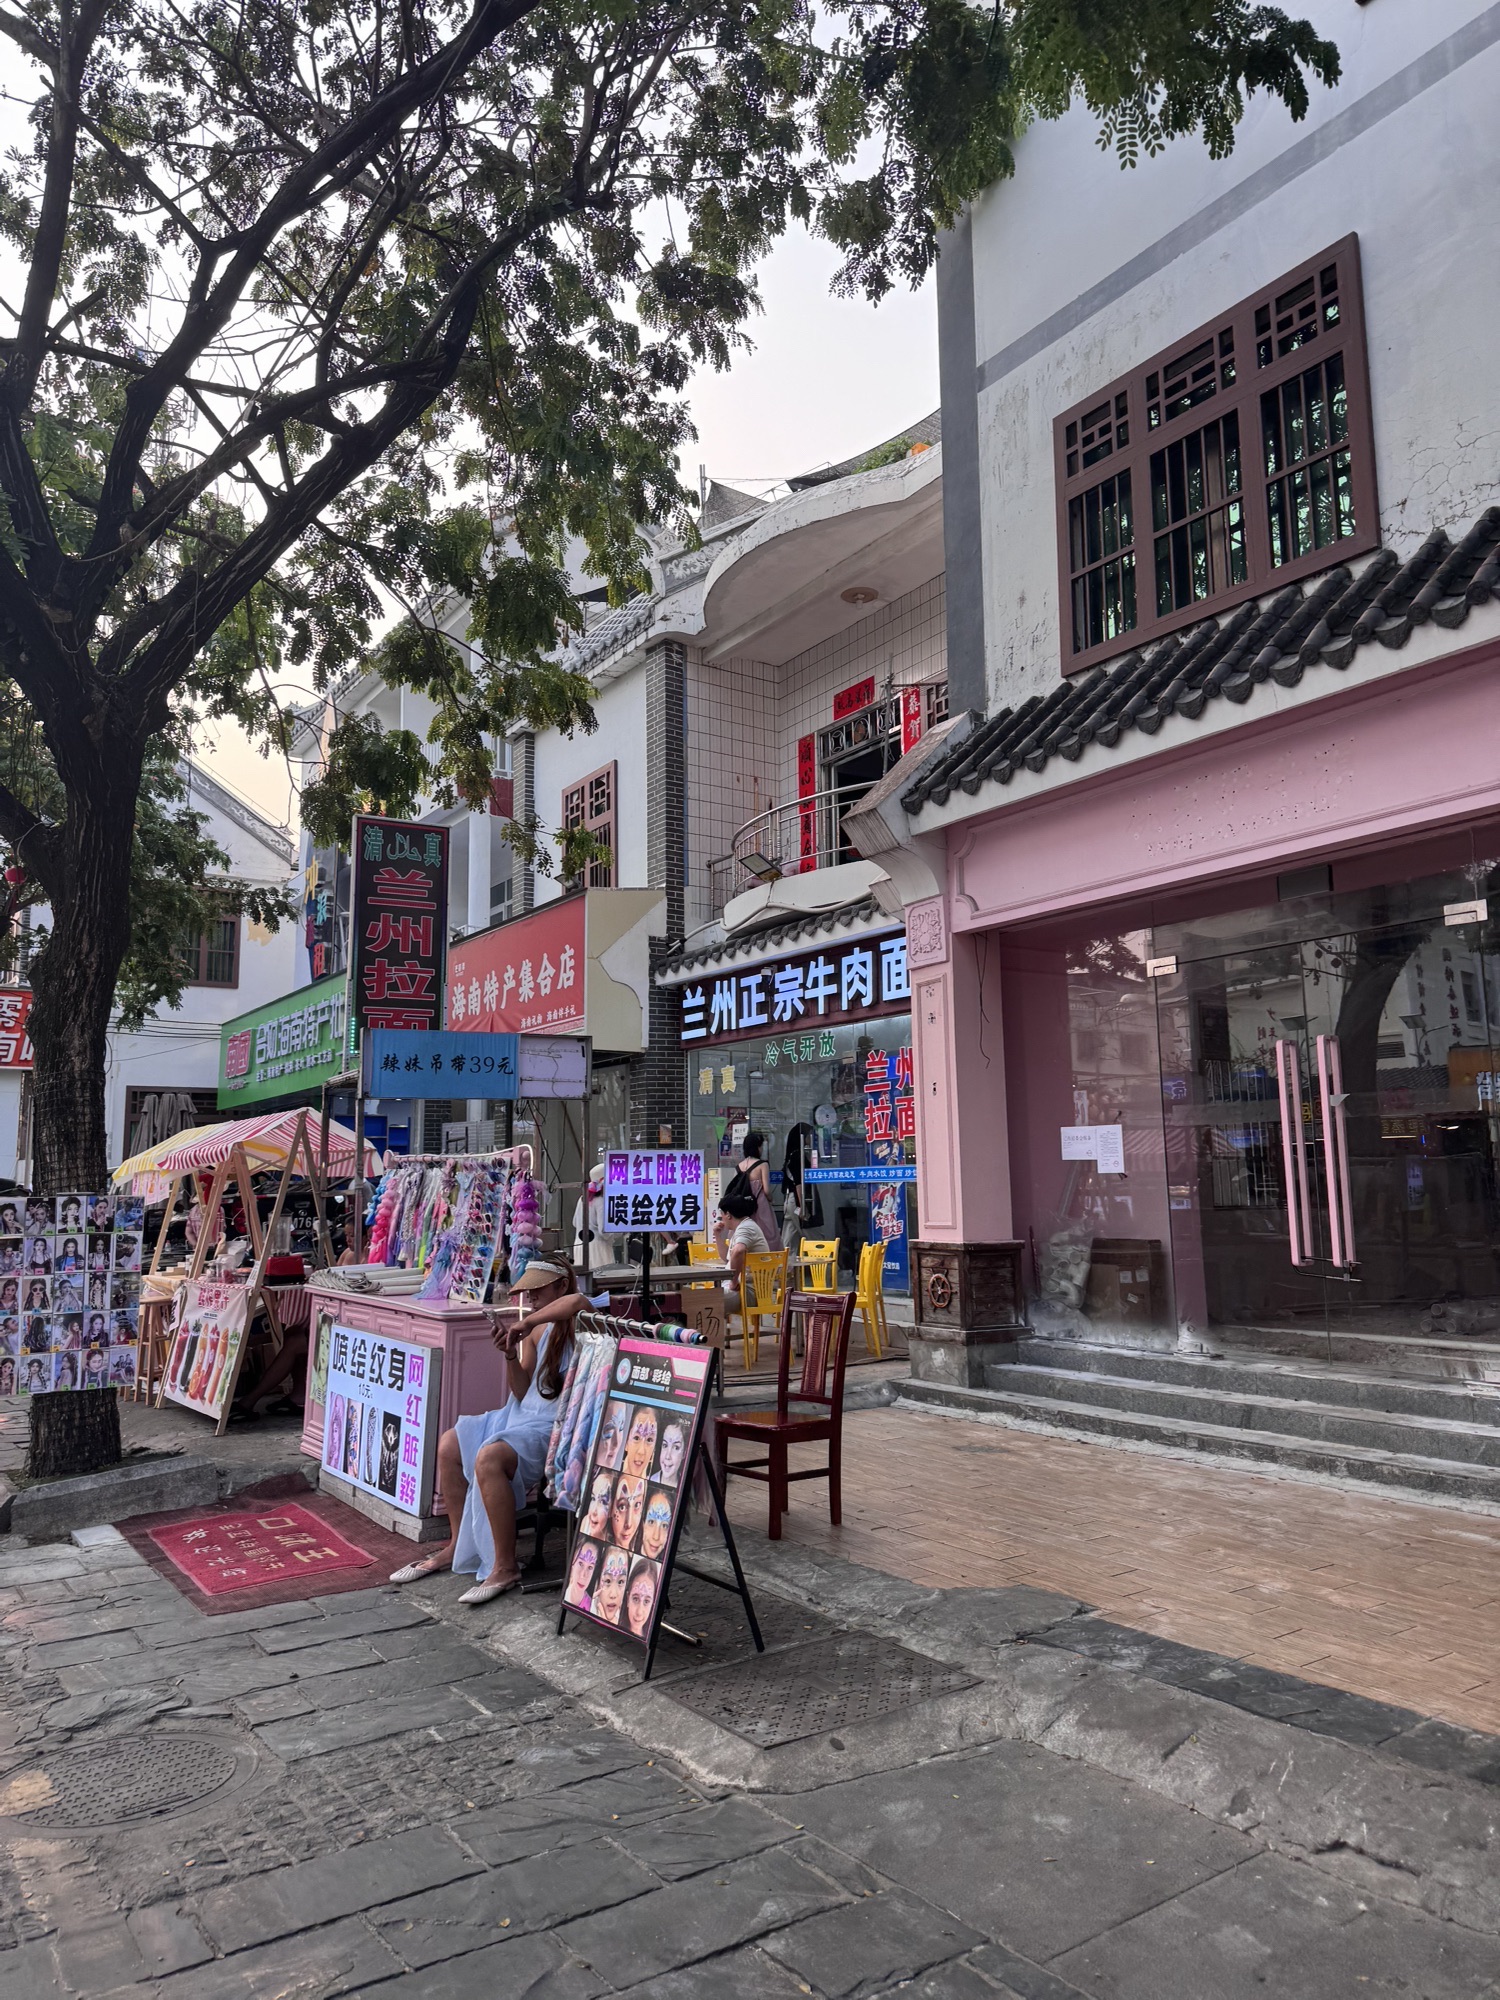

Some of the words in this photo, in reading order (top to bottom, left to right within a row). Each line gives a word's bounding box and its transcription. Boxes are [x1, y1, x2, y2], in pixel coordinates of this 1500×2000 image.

[364, 825, 385, 862] 清
[423, 832, 442, 867] 真
[452, 944, 575, 1021] 海南特产集合店
[681, 937, 912, 1041] 兰州正宗牛肉面
[0, 995, 33, 1028] 零
[380, 1053, 514, 1076] 辣妹吊带39元
[765, 1030, 836, 1067] 冷气开放
[699, 1064, 737, 1096] 清真
[864, 1096, 916, 1143] 拉面
[608, 1153, 701, 1185] 网红脏辫
[607, 1194, 701, 1226] 喷绘纹身
[333, 1332, 406, 1392] 喷绘纹身
[400, 1353, 425, 1506] 网红脏辫
